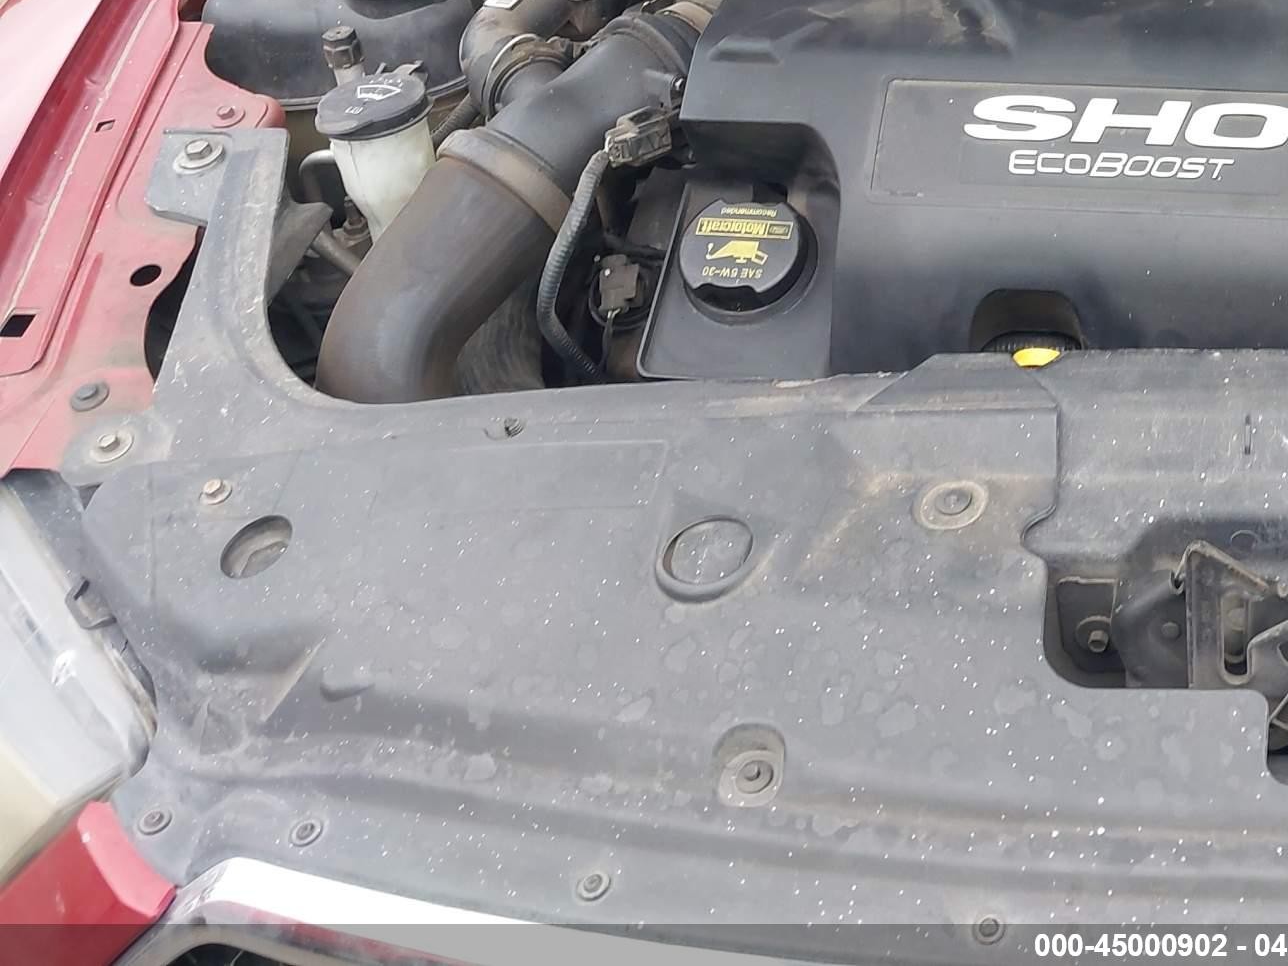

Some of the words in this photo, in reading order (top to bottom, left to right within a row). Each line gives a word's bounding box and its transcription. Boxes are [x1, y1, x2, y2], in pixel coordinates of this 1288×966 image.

[720, 206, 778, 218] Recommended
[700, 220, 767, 236] Motorcraft
[740, 266, 763, 279] SAE
